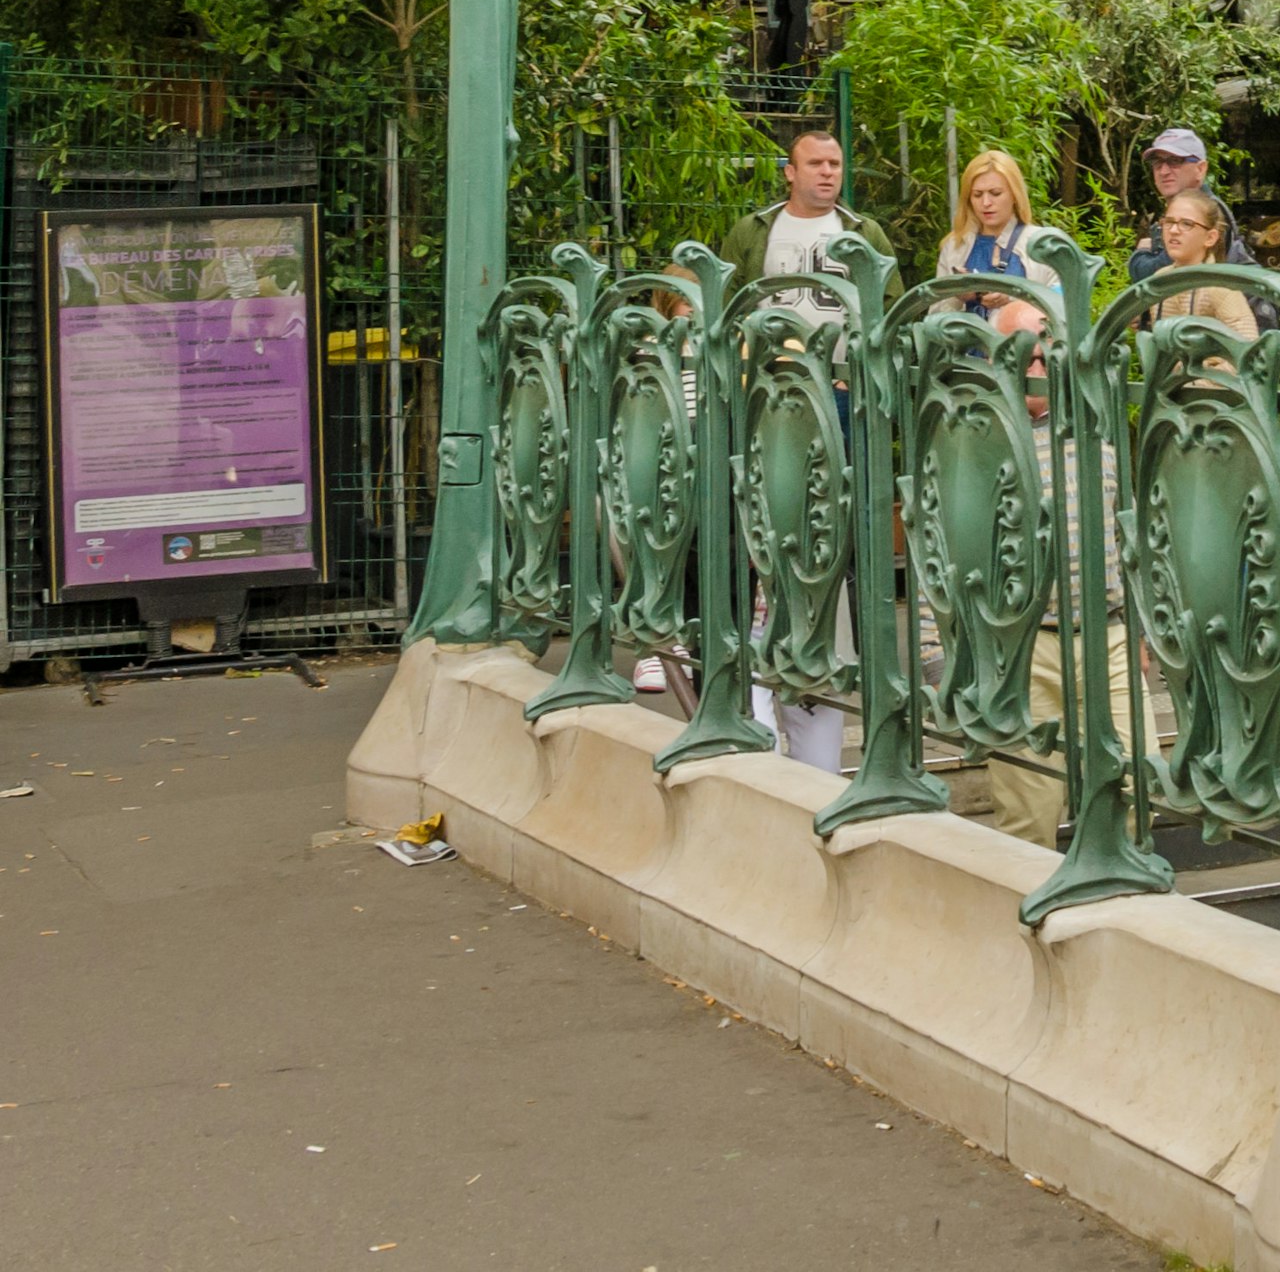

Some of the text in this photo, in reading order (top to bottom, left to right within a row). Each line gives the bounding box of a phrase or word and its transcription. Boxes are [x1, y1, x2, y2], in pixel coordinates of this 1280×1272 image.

[88, 250, 150, 265] BUREAU
[153, 249, 181, 262] DES
[184, 246, 242, 261] CARTES
[102, 262, 262, 296] DÉMÉNA
